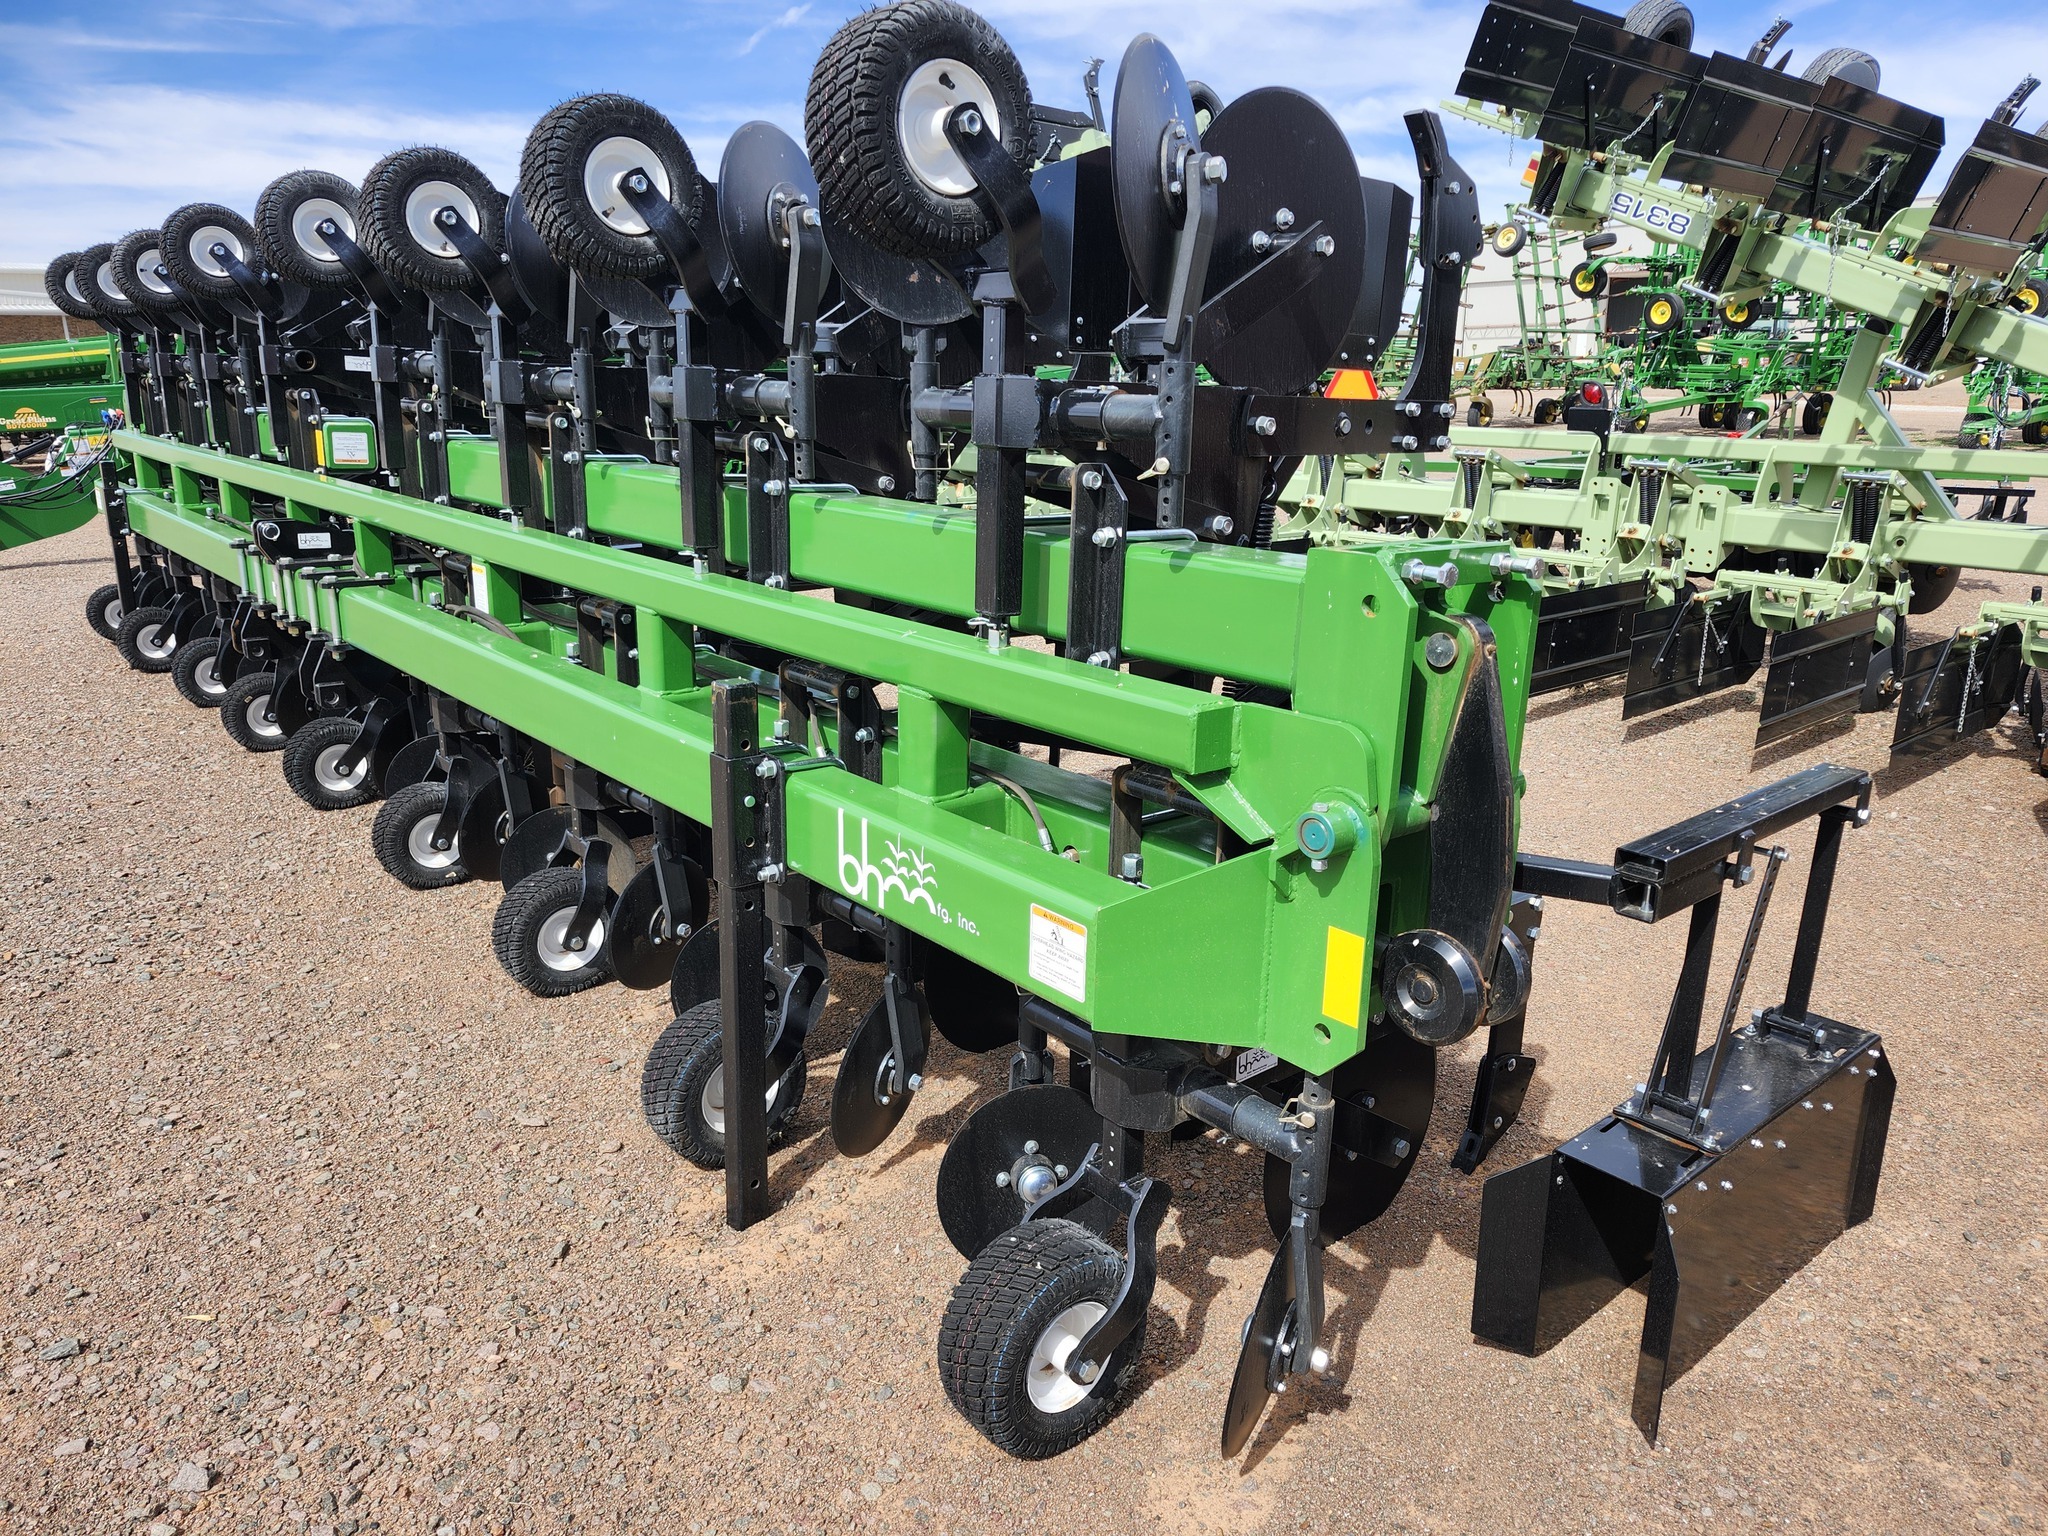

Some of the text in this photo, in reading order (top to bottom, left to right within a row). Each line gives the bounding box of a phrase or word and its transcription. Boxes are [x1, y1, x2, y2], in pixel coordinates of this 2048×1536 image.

[1612, 191, 1692, 236] 8315
[0, 417, 26, 425] Great
[957, 911, 981, 937] inc.
[1049, 914, 1074, 930] WARNING
